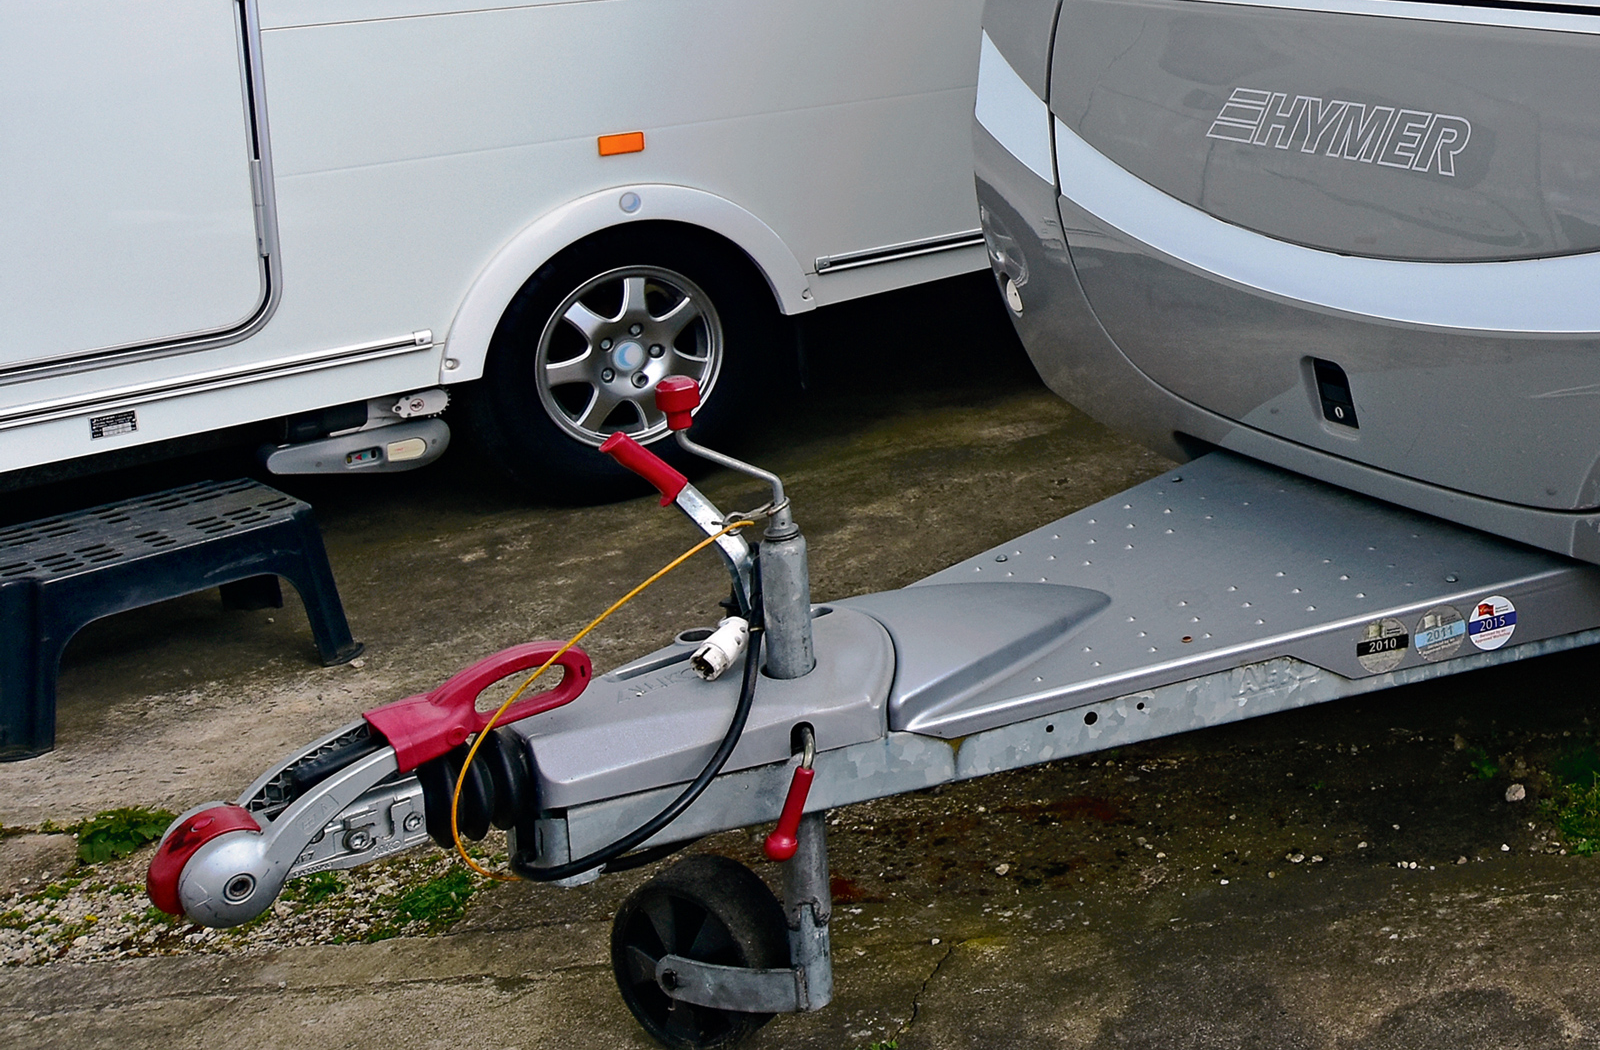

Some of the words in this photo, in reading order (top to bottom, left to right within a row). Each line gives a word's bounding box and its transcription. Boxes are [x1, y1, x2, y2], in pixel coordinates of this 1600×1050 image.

[1252, 92, 1473, 178] HYMER
[1479, 615, 1506, 632] 2015
[1426, 625, 1454, 643] 2011
[1368, 637, 1398, 653] 2010
